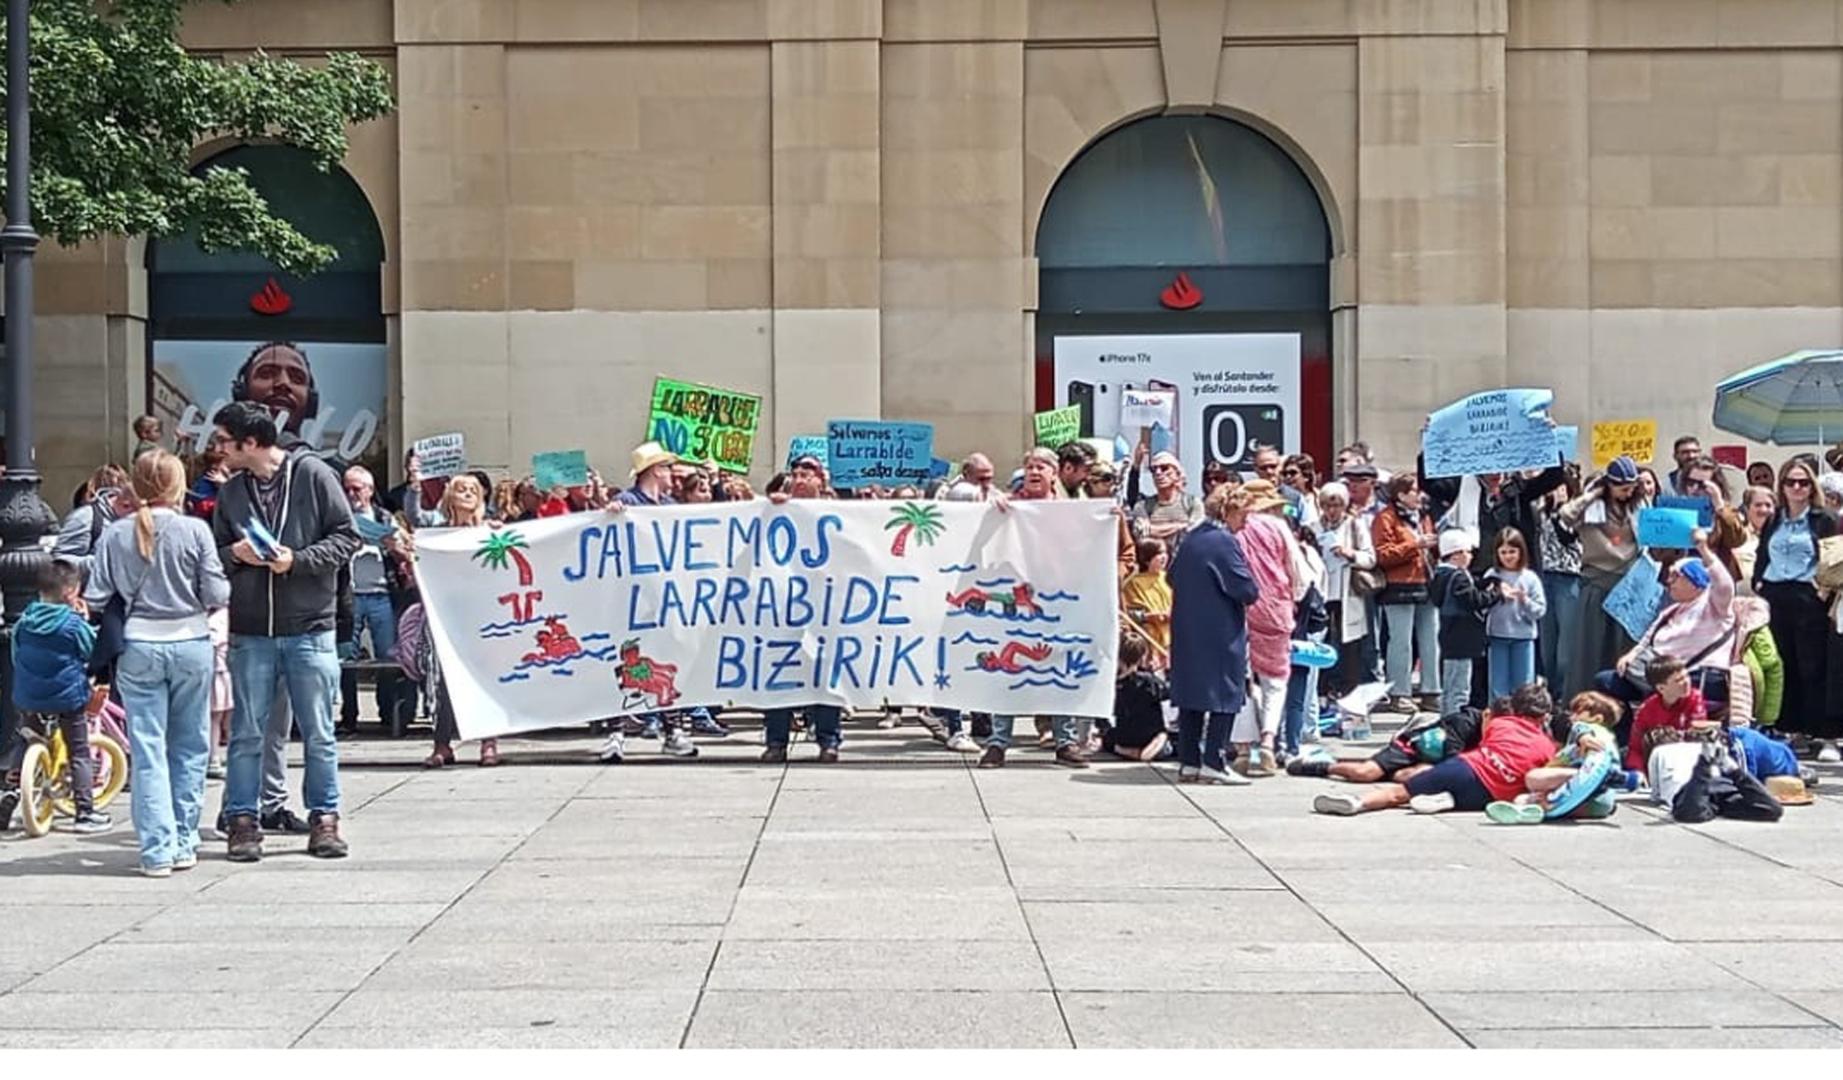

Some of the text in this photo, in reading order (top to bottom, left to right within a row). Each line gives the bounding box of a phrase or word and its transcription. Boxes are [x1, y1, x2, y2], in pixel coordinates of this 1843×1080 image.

[1107, 354, 1136, 363] iPhone
[1192, 371, 1274, 382] Ven al Santander
[1193, 386, 1199, 397] y
[178, 398, 377, 461] HLO
[830, 423, 892, 440] Salvemos
[563, 514, 843, 582] SALVEMOS
